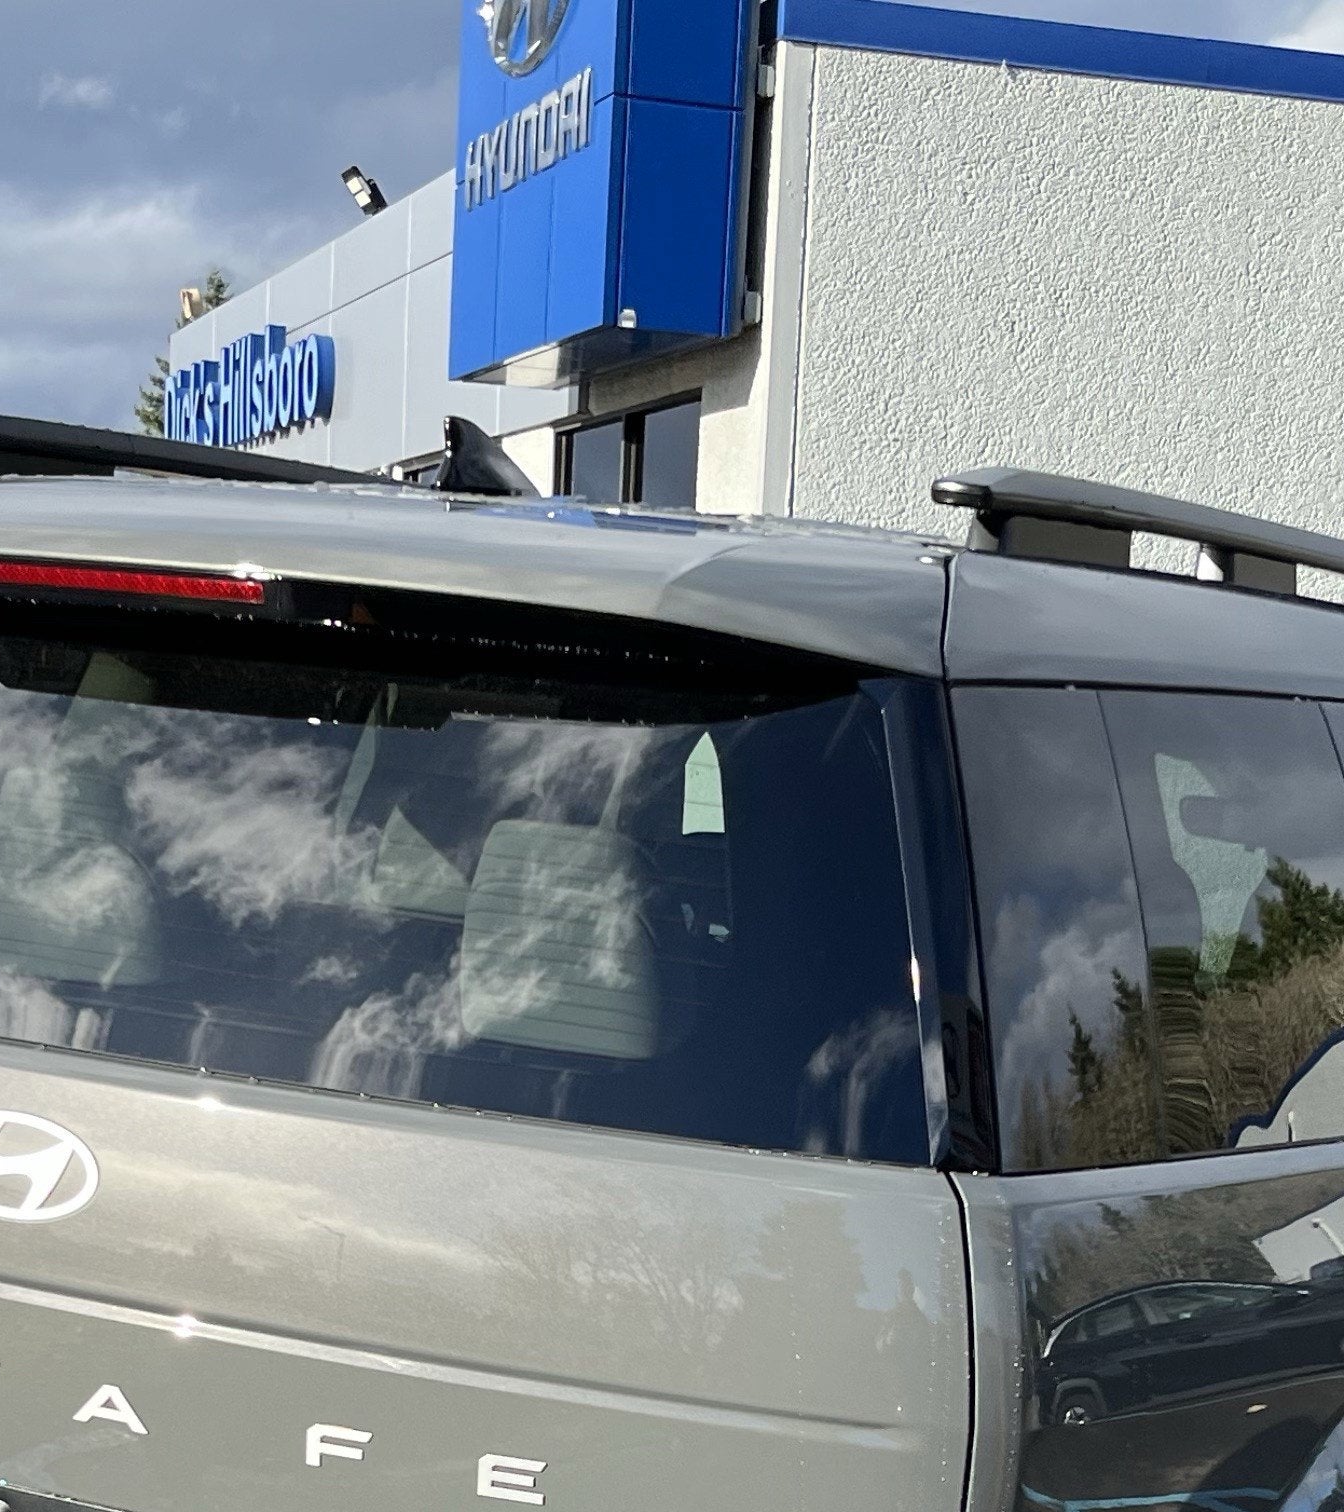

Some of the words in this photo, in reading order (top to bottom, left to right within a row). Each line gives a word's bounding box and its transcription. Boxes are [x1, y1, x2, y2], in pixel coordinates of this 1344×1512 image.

[465, 65, 593, 212] HYUNDAI
[164, 360, 216, 447] Dick's
[219, 324, 326, 448] Hillsboro
[305, 1422, 549, 1506] FE
